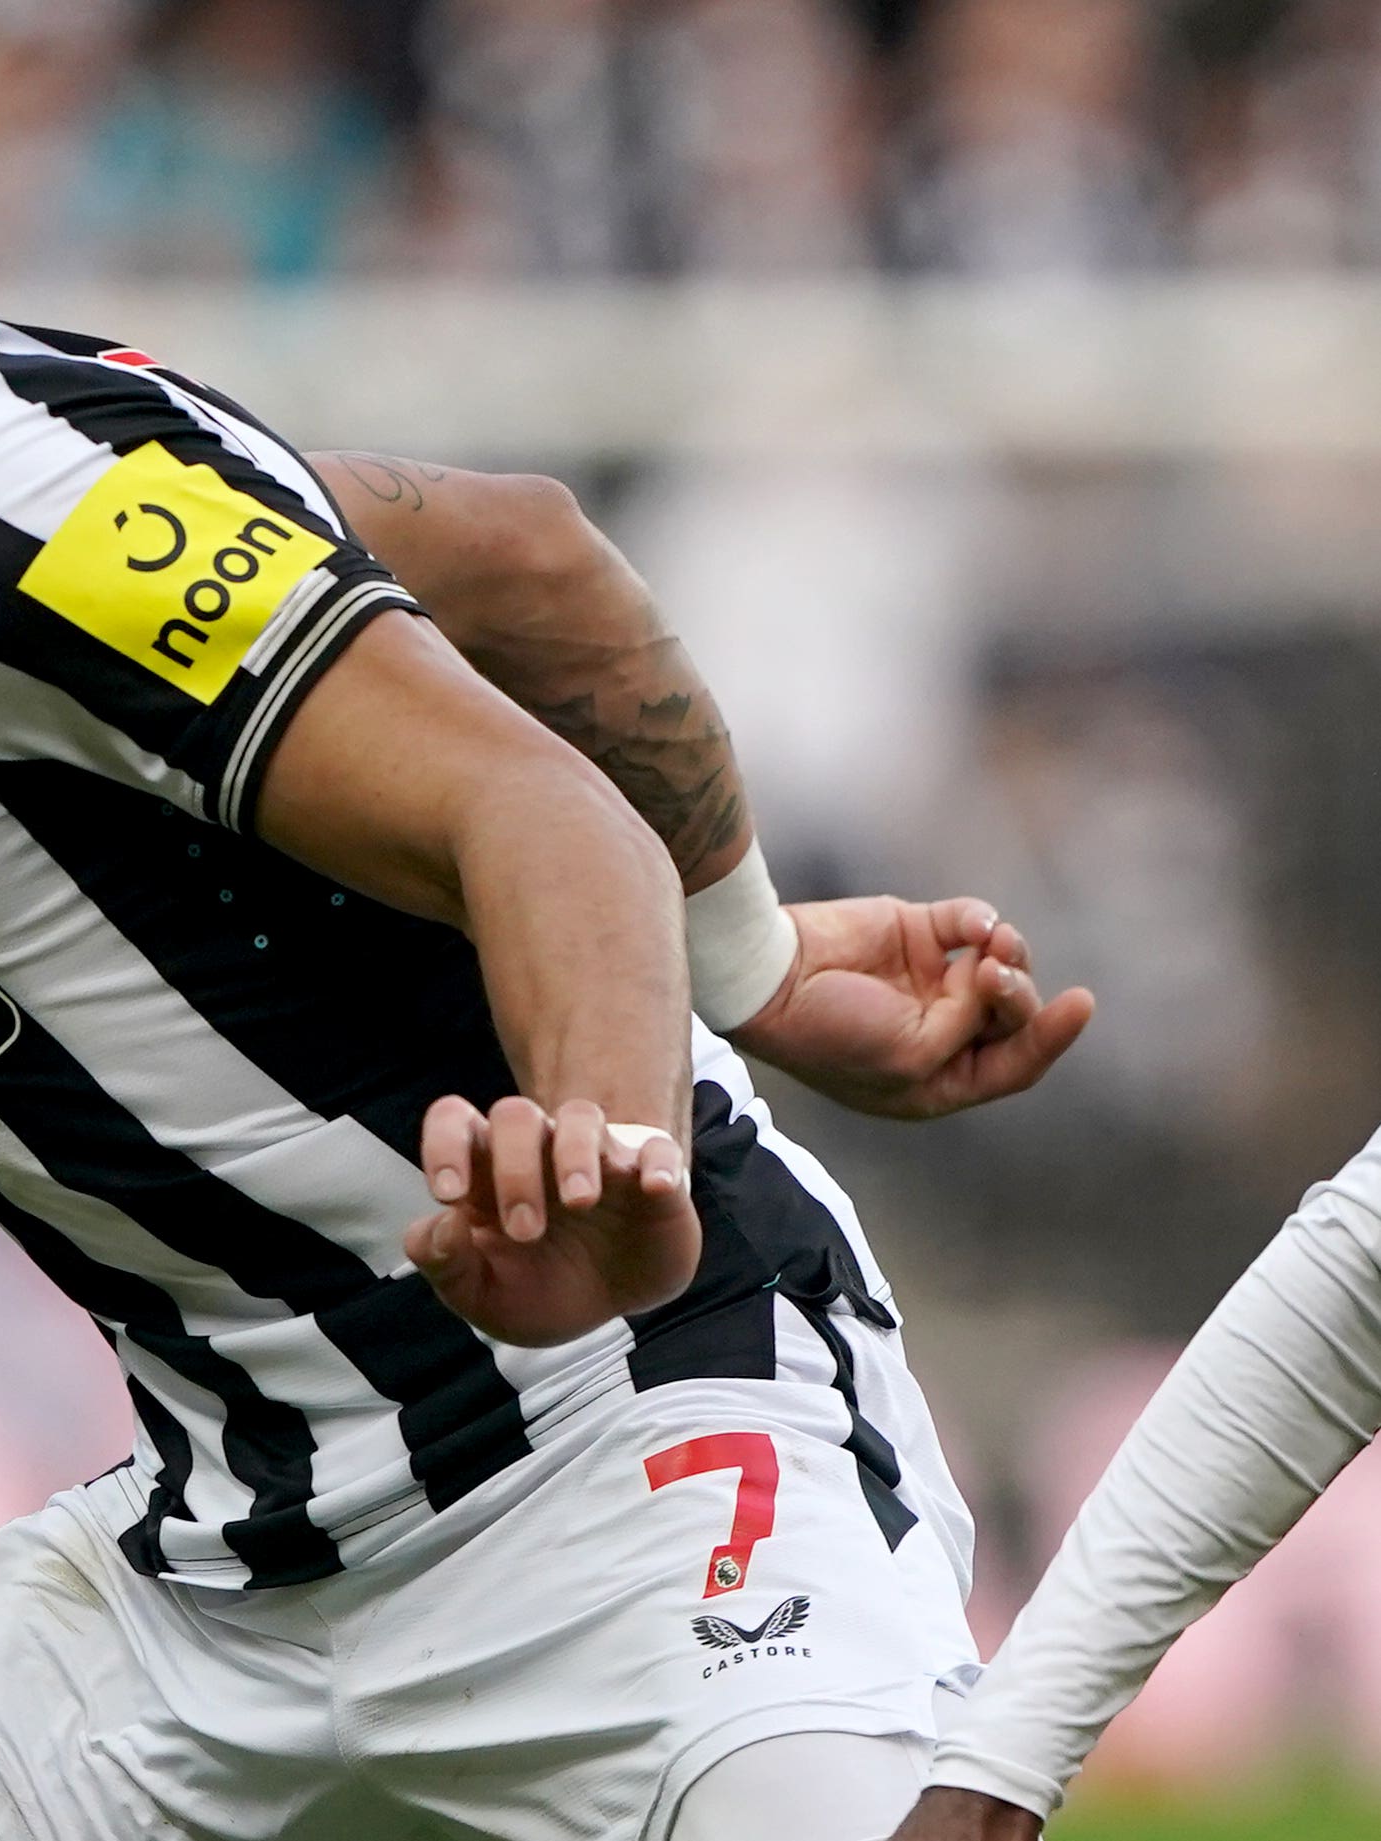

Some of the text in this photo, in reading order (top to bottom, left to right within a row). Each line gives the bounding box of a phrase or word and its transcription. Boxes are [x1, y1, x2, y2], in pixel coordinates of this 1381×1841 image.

[151, 516, 293, 669] noon
[643, 1432, 780, 1599] 7
[702, 1646, 813, 1680] CASTORE
